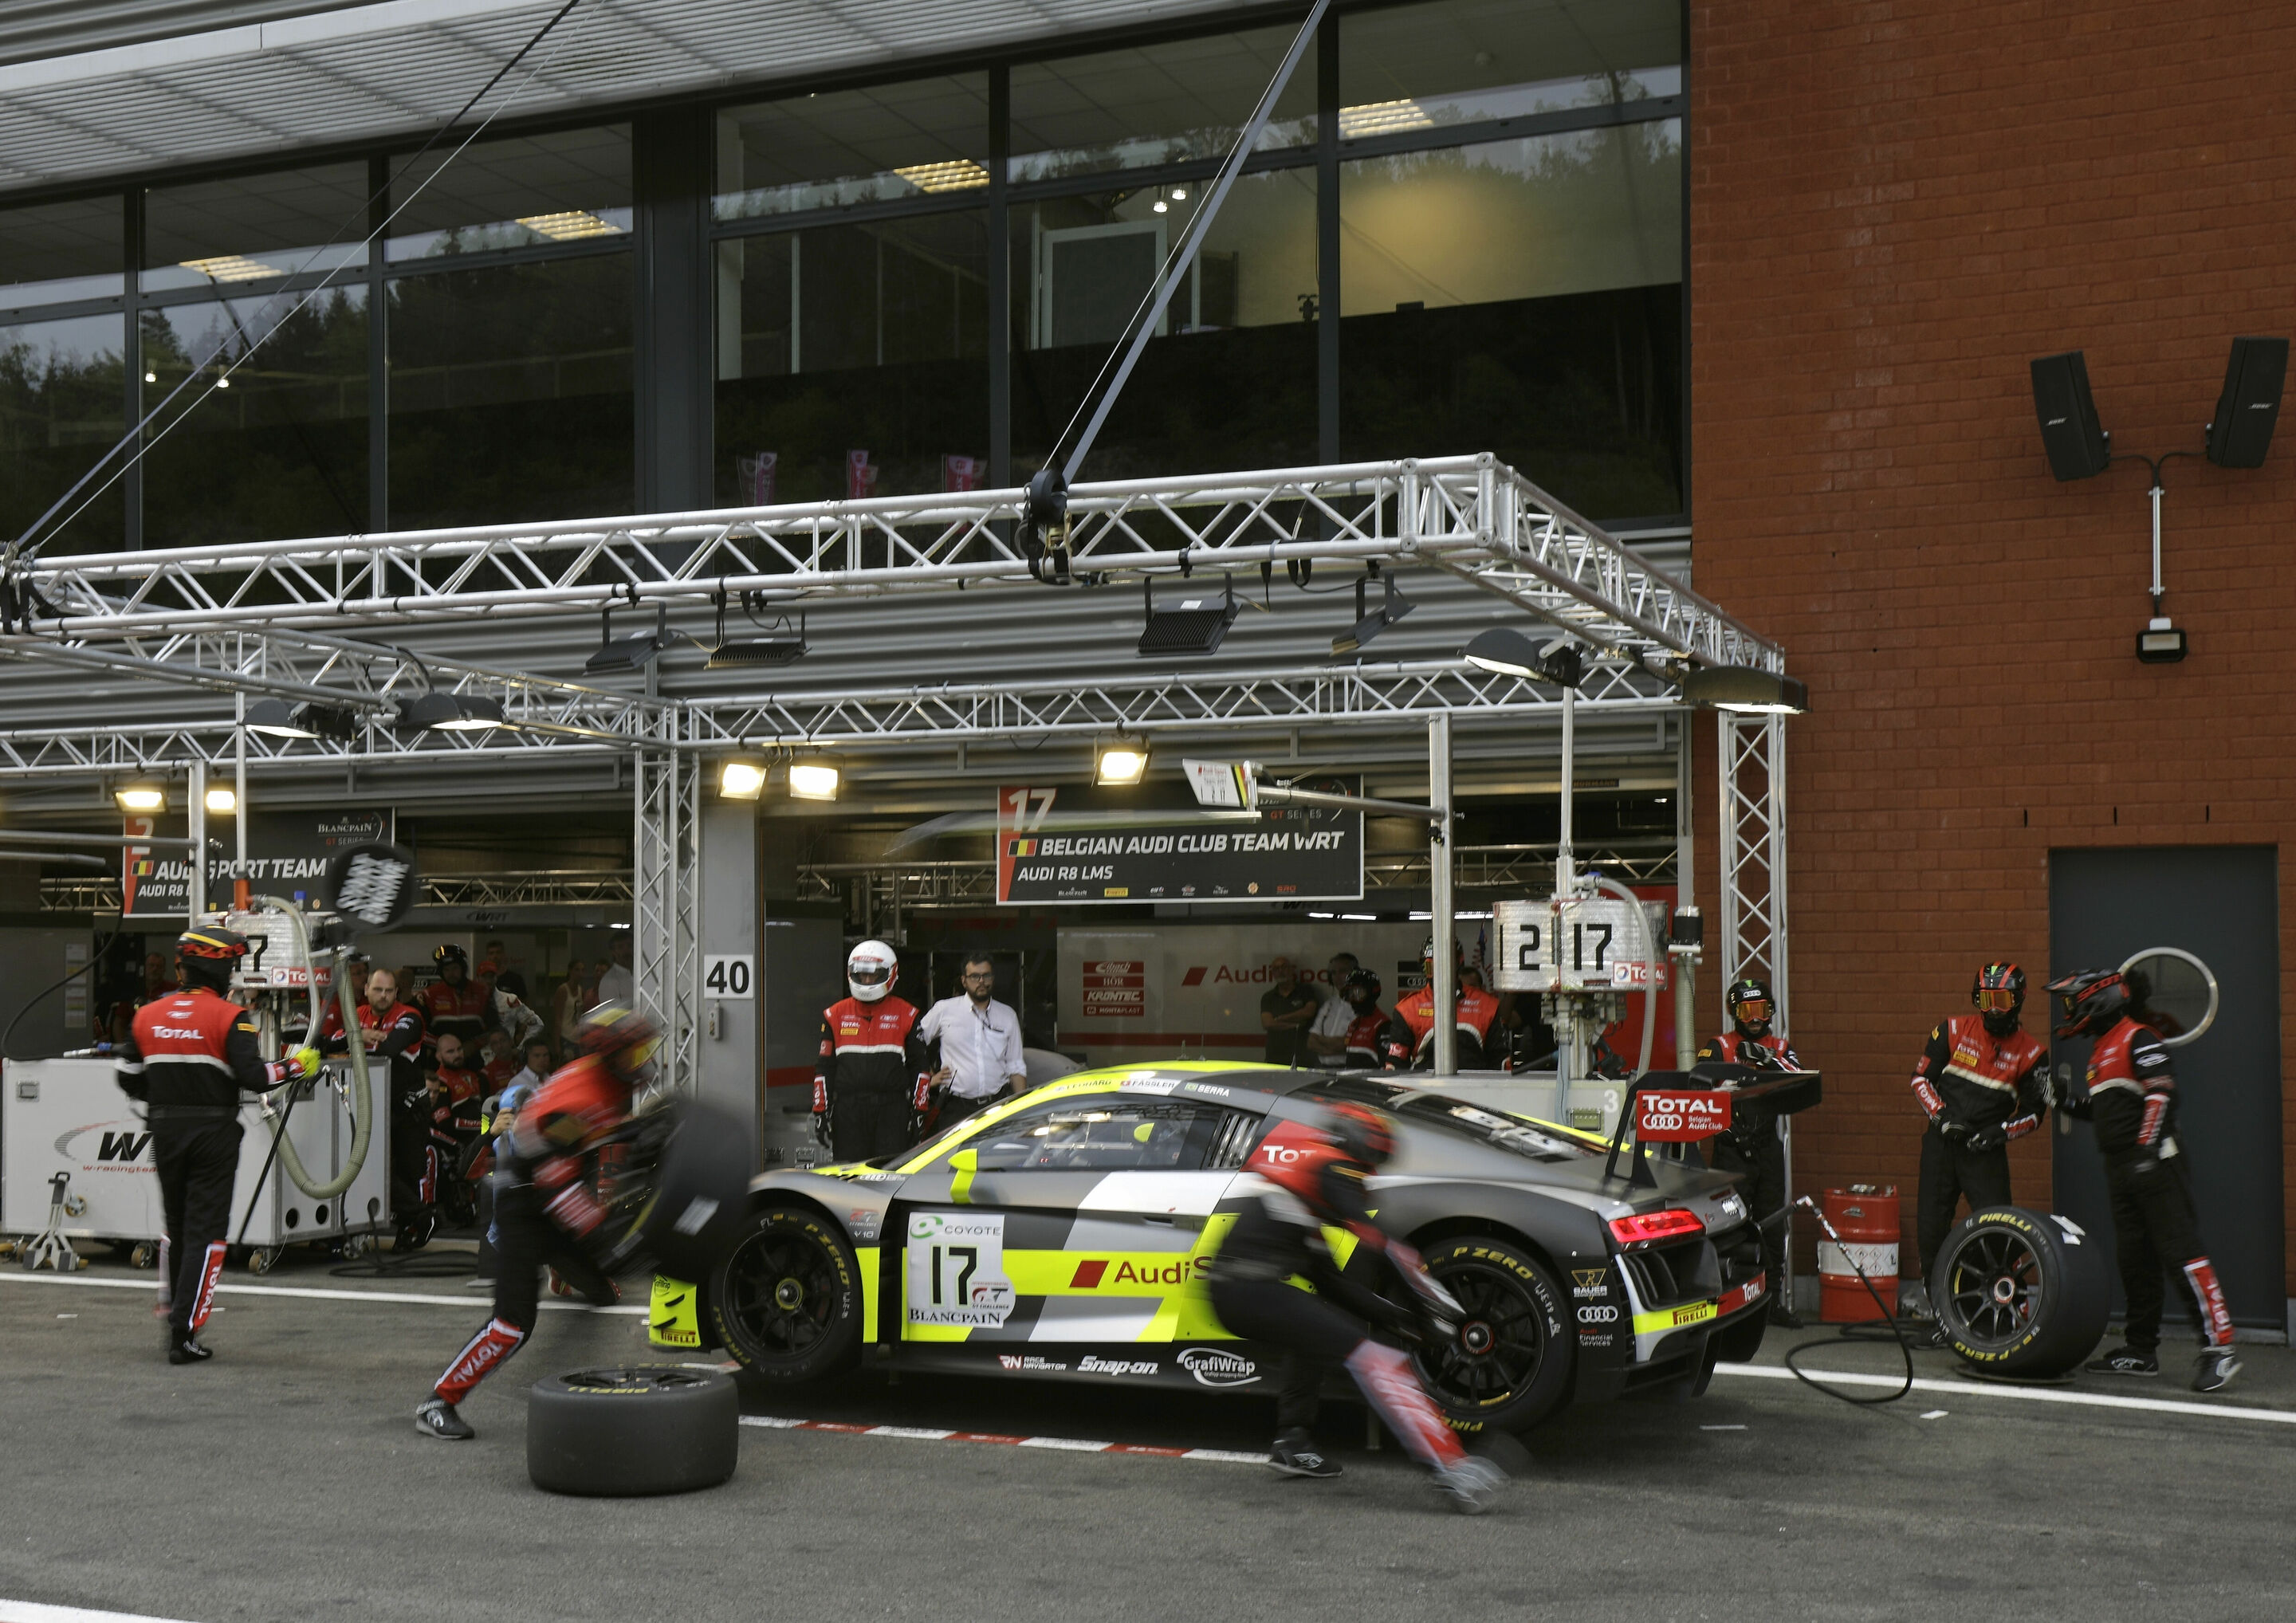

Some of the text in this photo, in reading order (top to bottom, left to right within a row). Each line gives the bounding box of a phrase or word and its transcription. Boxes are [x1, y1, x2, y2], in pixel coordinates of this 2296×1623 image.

[1008, 788, 1057, 832] 17
[1271, 811, 1284, 819] GT
[318, 823, 372, 833] BLANCPAIN
[1040, 831, 1345, 856] BELGIAN AUDI CLUB TEAM WRT
[271, 858, 328, 879] TEAM
[1017, 865, 1114, 881] AUDI R8 LMS
[138, 884, 167, 897] AUDI
[168, 884, 184, 897] R8
[1519, 925, 1540, 971] 2
[1573, 924, 1612, 971] 17
[706, 961, 749, 994] 40
[1214, 965, 1276, 984] Audi
[151, 1025, 204, 1040] TOTAL
[1604, 1090, 1618, 1114] 3
[1642, 1094, 1723, 1114] TOTAL
[1688, 1115, 1712, 1124] Belgian
[944, 1224, 1002, 1236] COYOTE
[1979, 1212, 2032, 1232] PIRELLI
[1453, 1247, 1534, 1280] P ZERO
[931, 1246, 977, 1306] 17
[1573, 1285, 1608, 1295] BAUER
[1742, 1280, 1761, 1303] TOTAL
[910, 1307, 1001, 1324] BLANCPAIN
[1673, 1302, 1708, 1326] PIRELLI
[452, 1340, 504, 1383] TOTAL
[1023, 1362, 1067, 1371] NAVIGATOR
[1077, 1355, 1159, 1377] Snap-on
[1184, 1355, 1256, 1376] GrafiWrap
